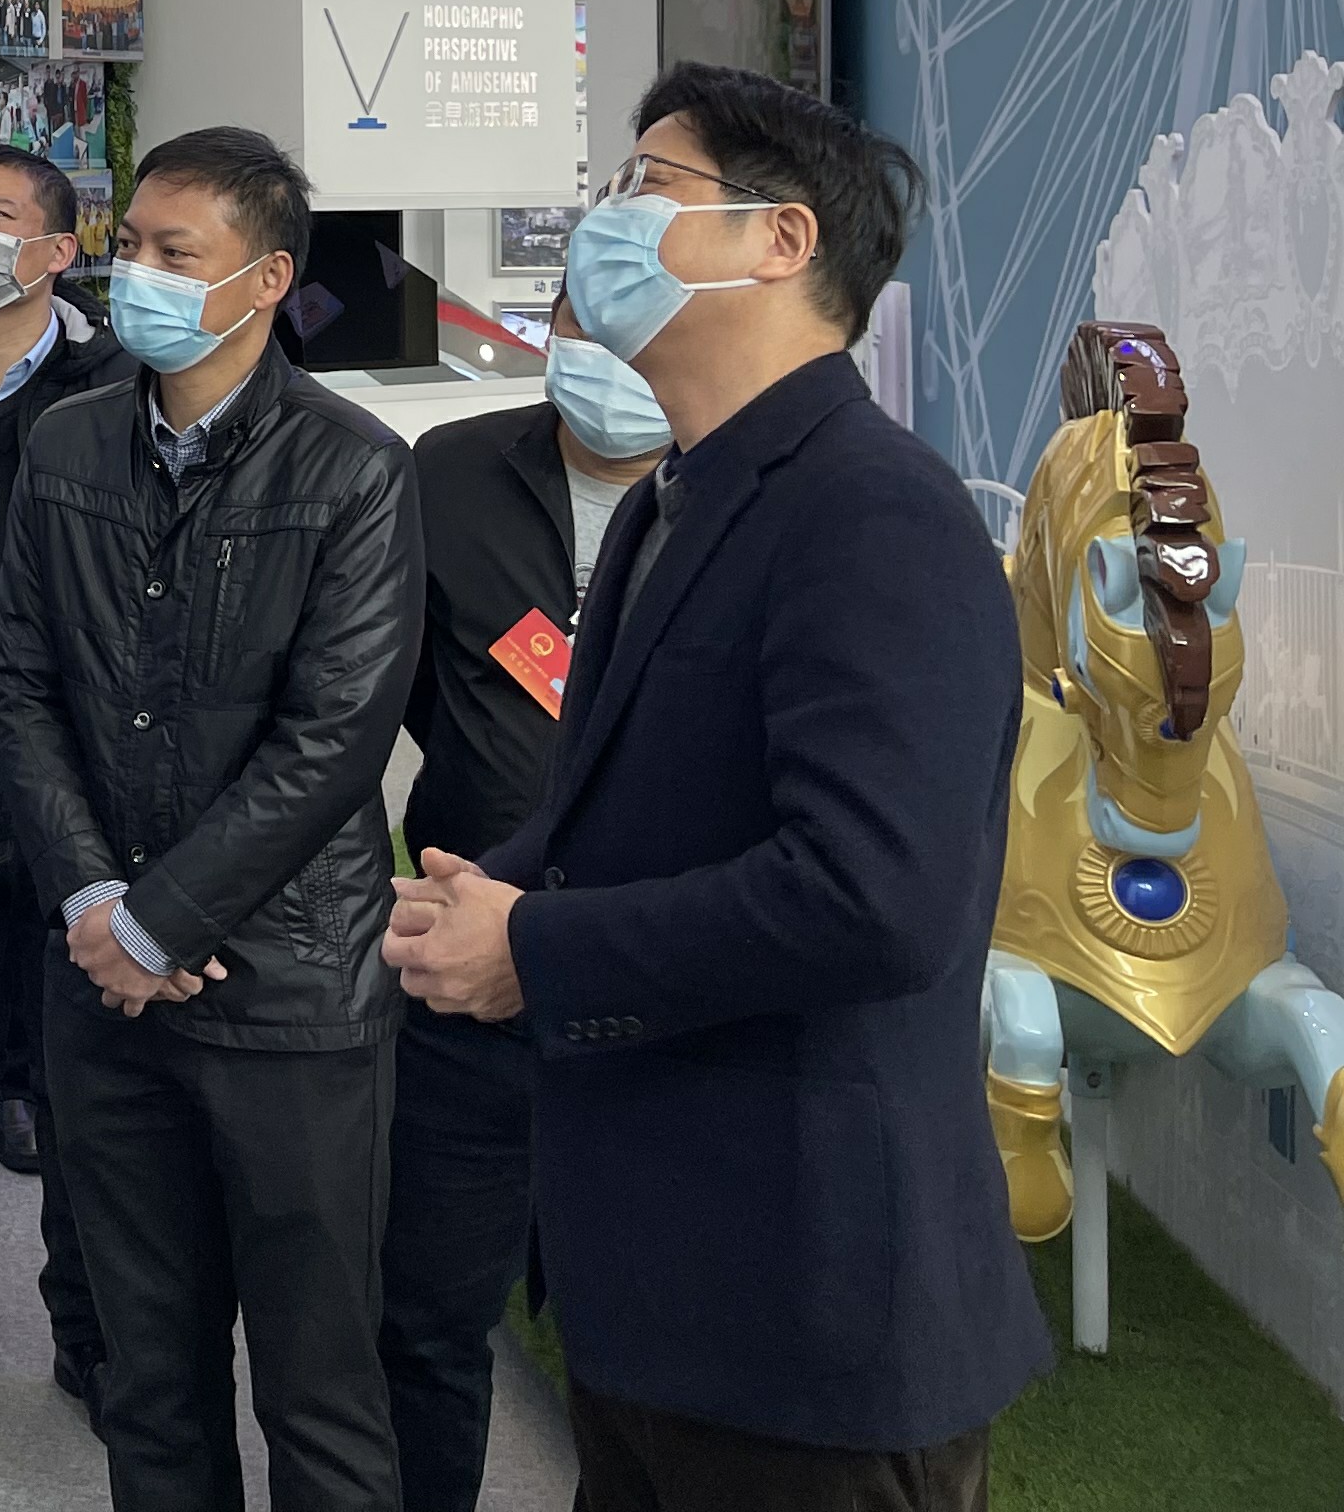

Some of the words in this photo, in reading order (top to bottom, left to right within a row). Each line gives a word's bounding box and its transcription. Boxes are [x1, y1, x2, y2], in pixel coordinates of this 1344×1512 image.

[424, 5, 523, 29] HOLOGRAPHIC
[424, 38, 517, 61] PERSPECTIVE
[425, 71, 441, 93] OF
[451, 71, 537, 94] AMUSEMENT
[425, 101, 539, 128] 全息游乐视角
